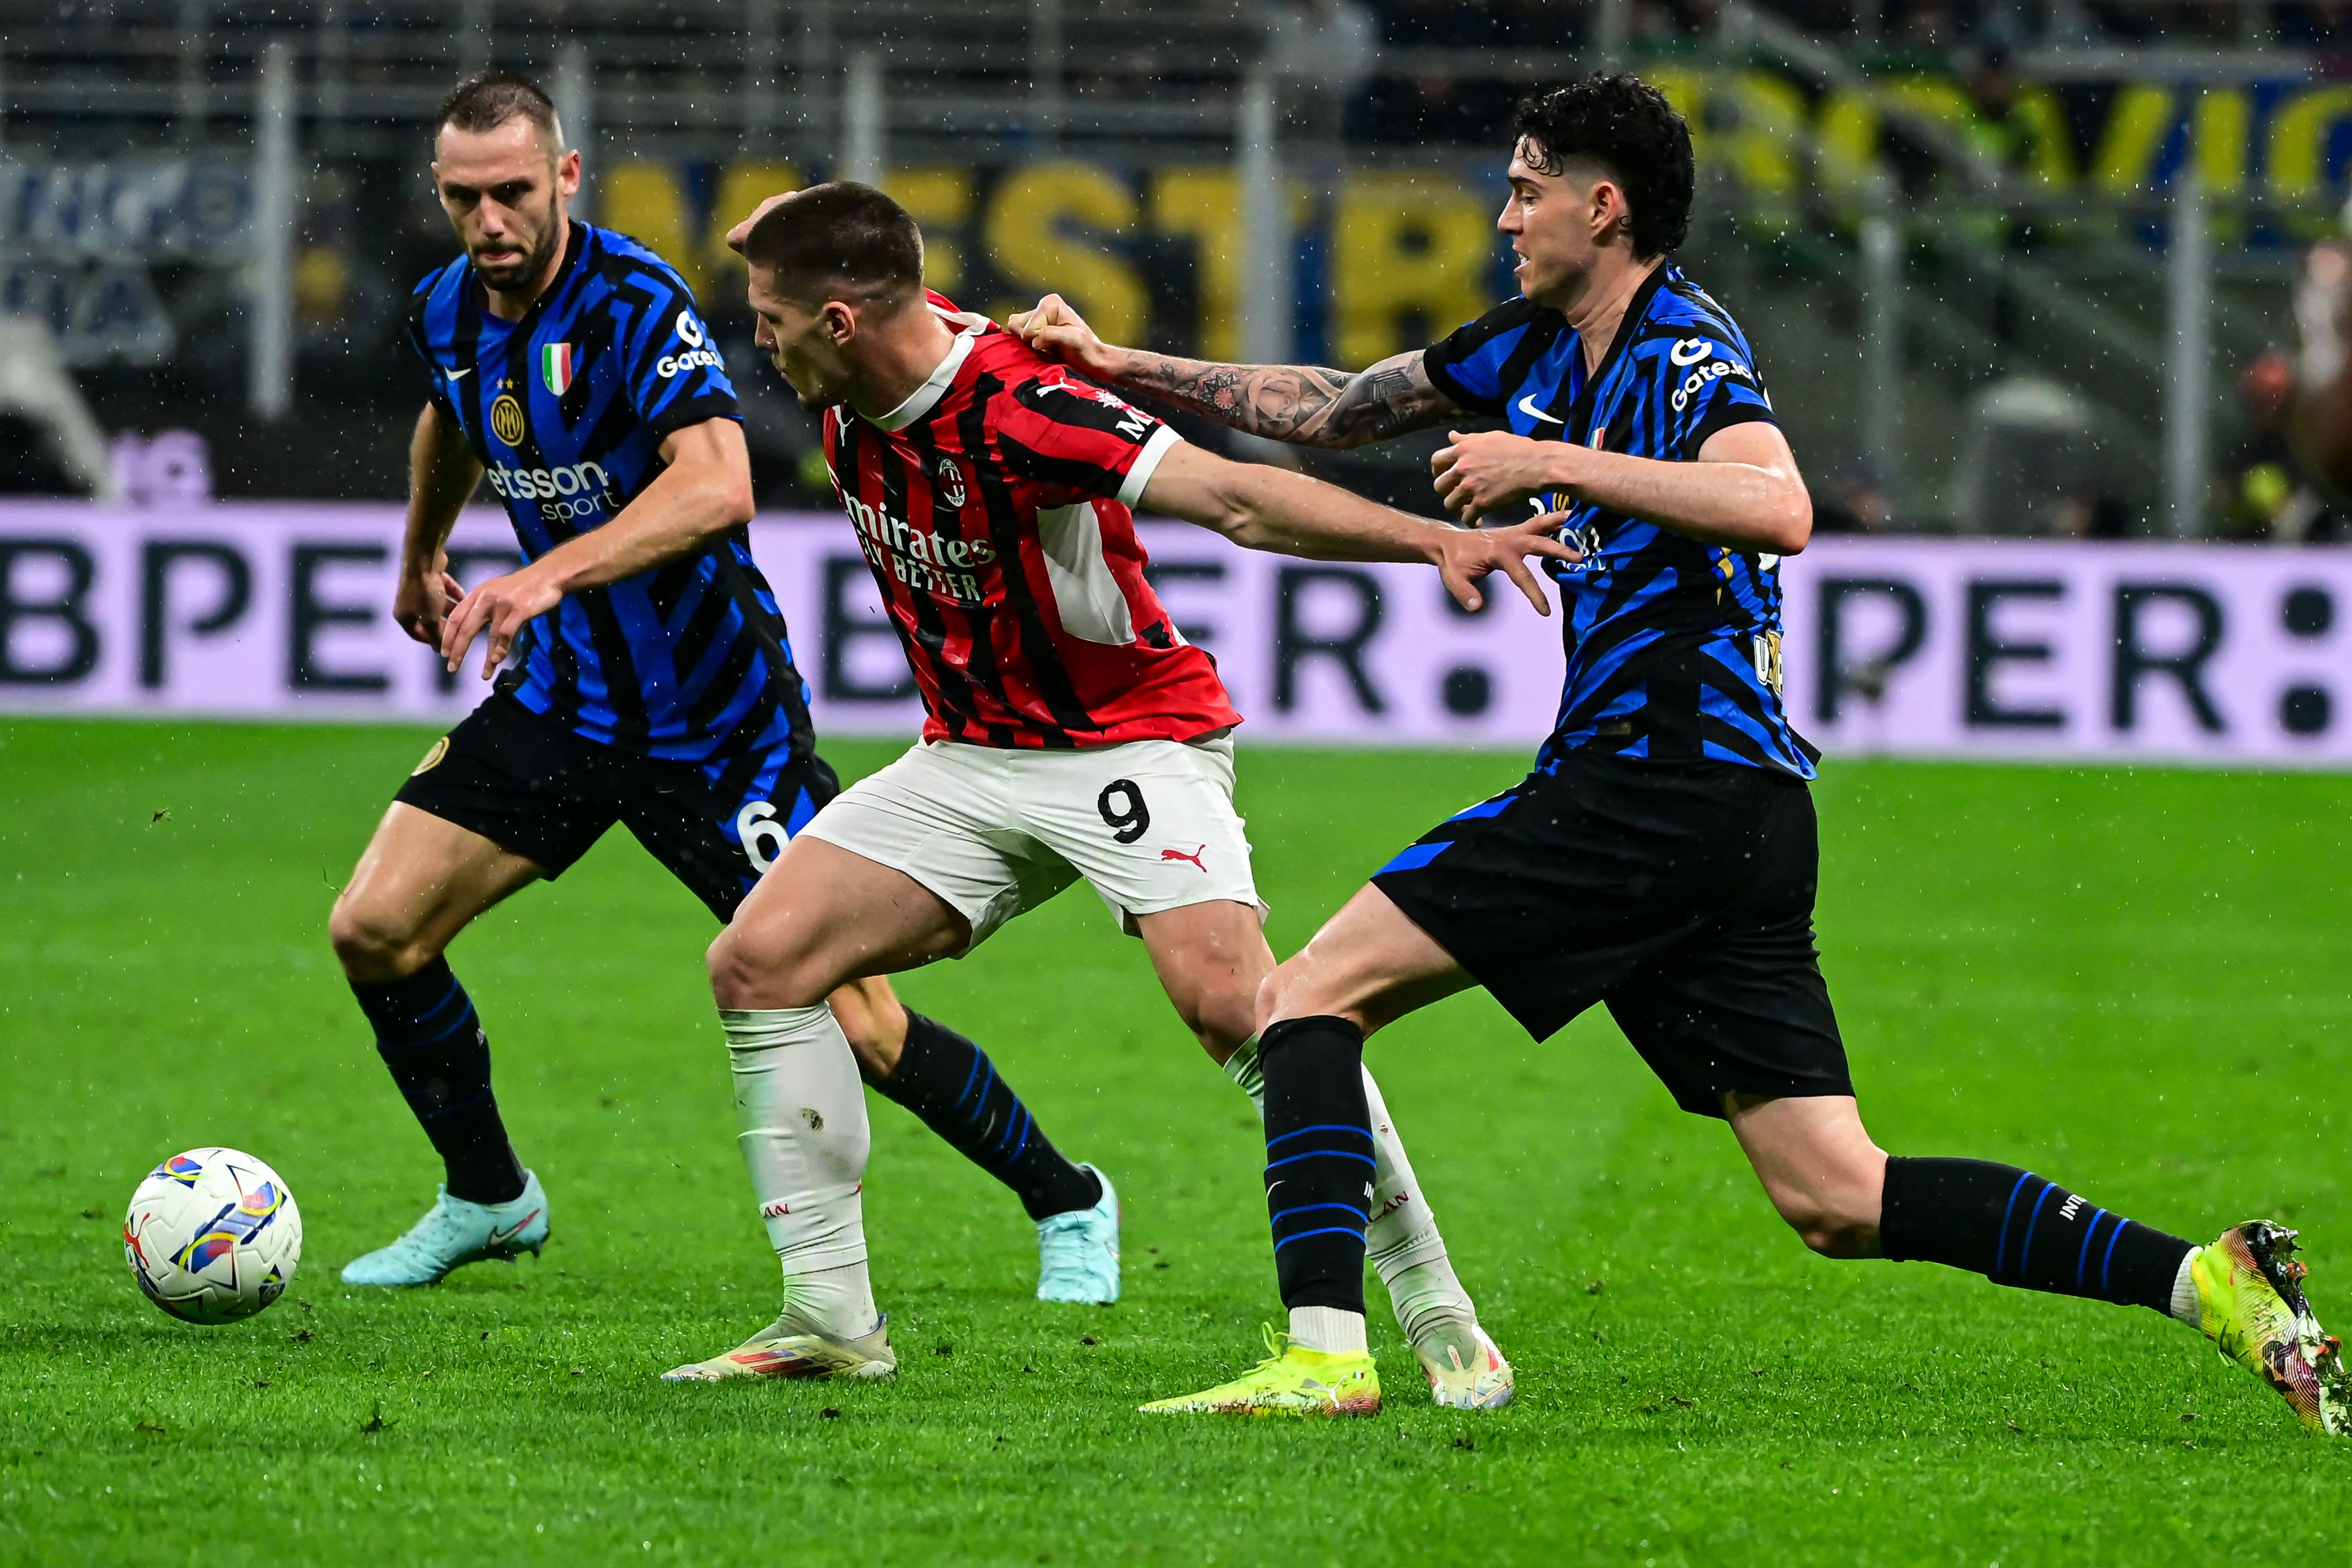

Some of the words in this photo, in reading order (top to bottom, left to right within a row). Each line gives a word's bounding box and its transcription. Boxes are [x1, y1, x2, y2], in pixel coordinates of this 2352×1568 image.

[826, 459, 996, 568] mirates
[891, 553, 981, 602] BETTER
[737, 800, 791, 874] 6
[1097, 778, 1150, 844] 9
